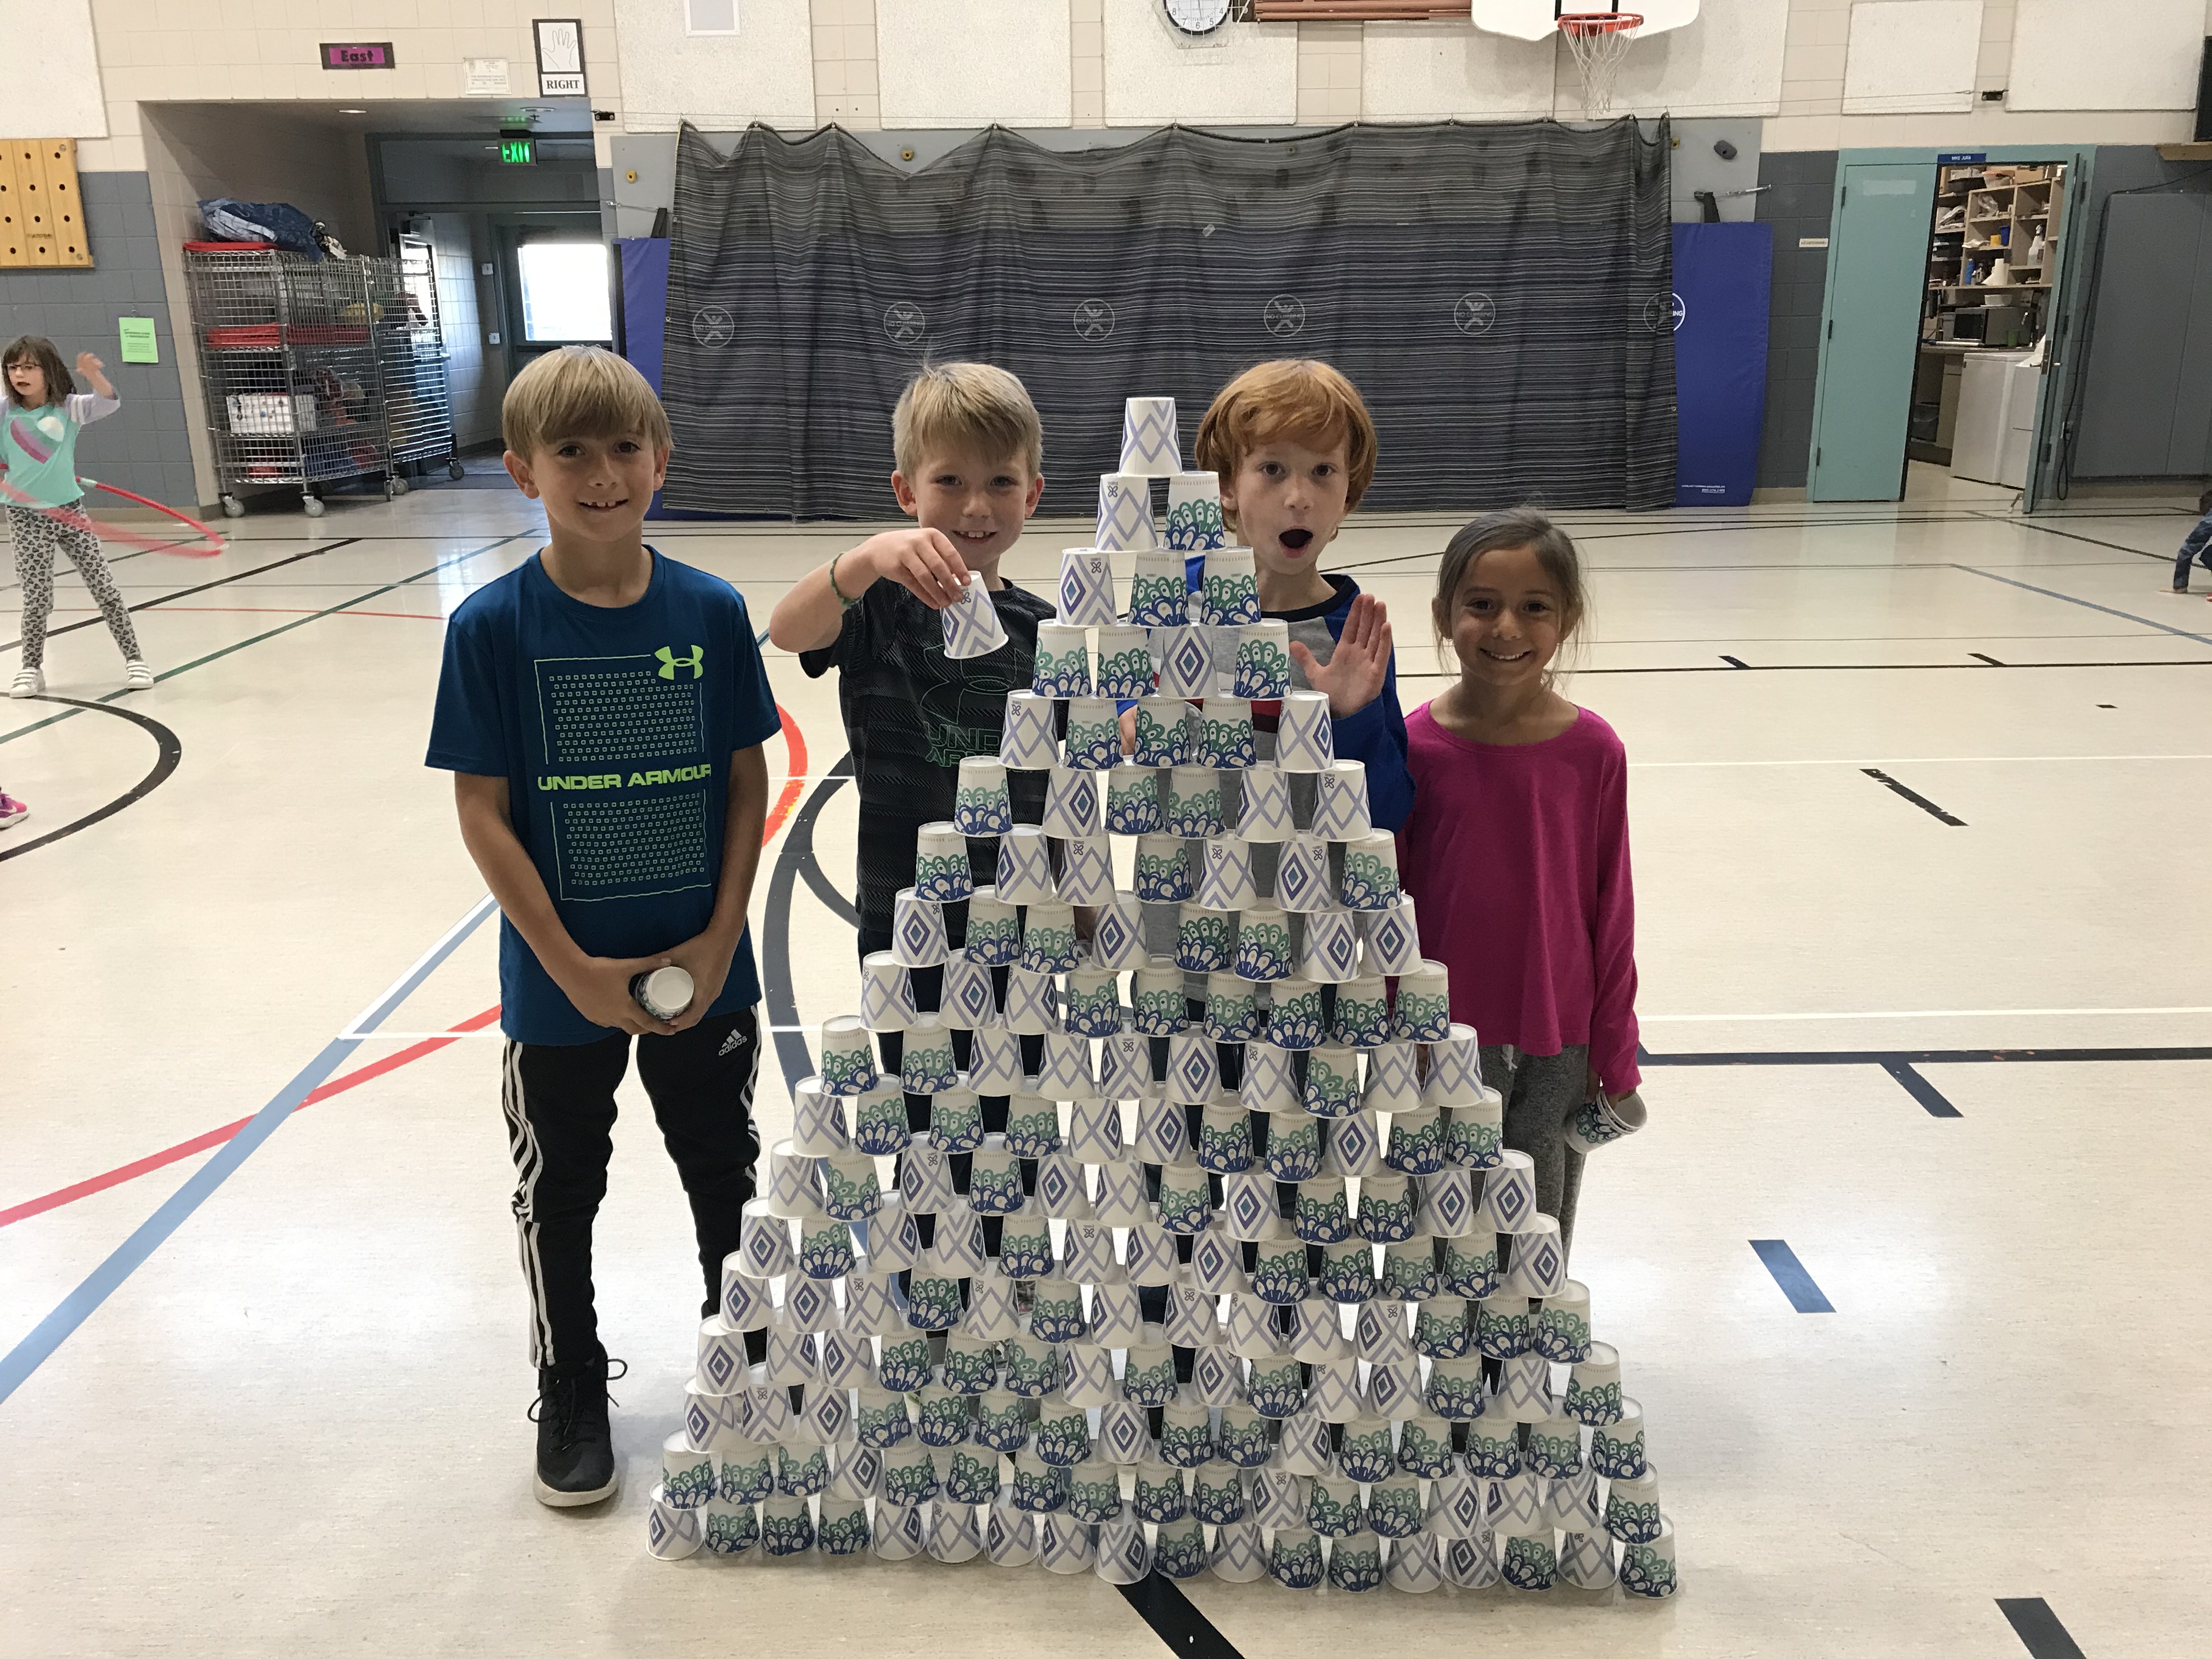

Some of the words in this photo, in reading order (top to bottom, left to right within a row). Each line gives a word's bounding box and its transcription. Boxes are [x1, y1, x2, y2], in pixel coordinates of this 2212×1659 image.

[1172, 8, 1177, 16] 8
[341, 50, 373, 62] East
[546, 80, 580, 89] RIGHT
[501, 141, 531, 163] EXIT
[923, 721, 1003, 752] UND
[538, 774, 622, 791] UNDER
[627, 764, 711, 787] ARMOUR
[718, 1036, 747, 1056] adidas
